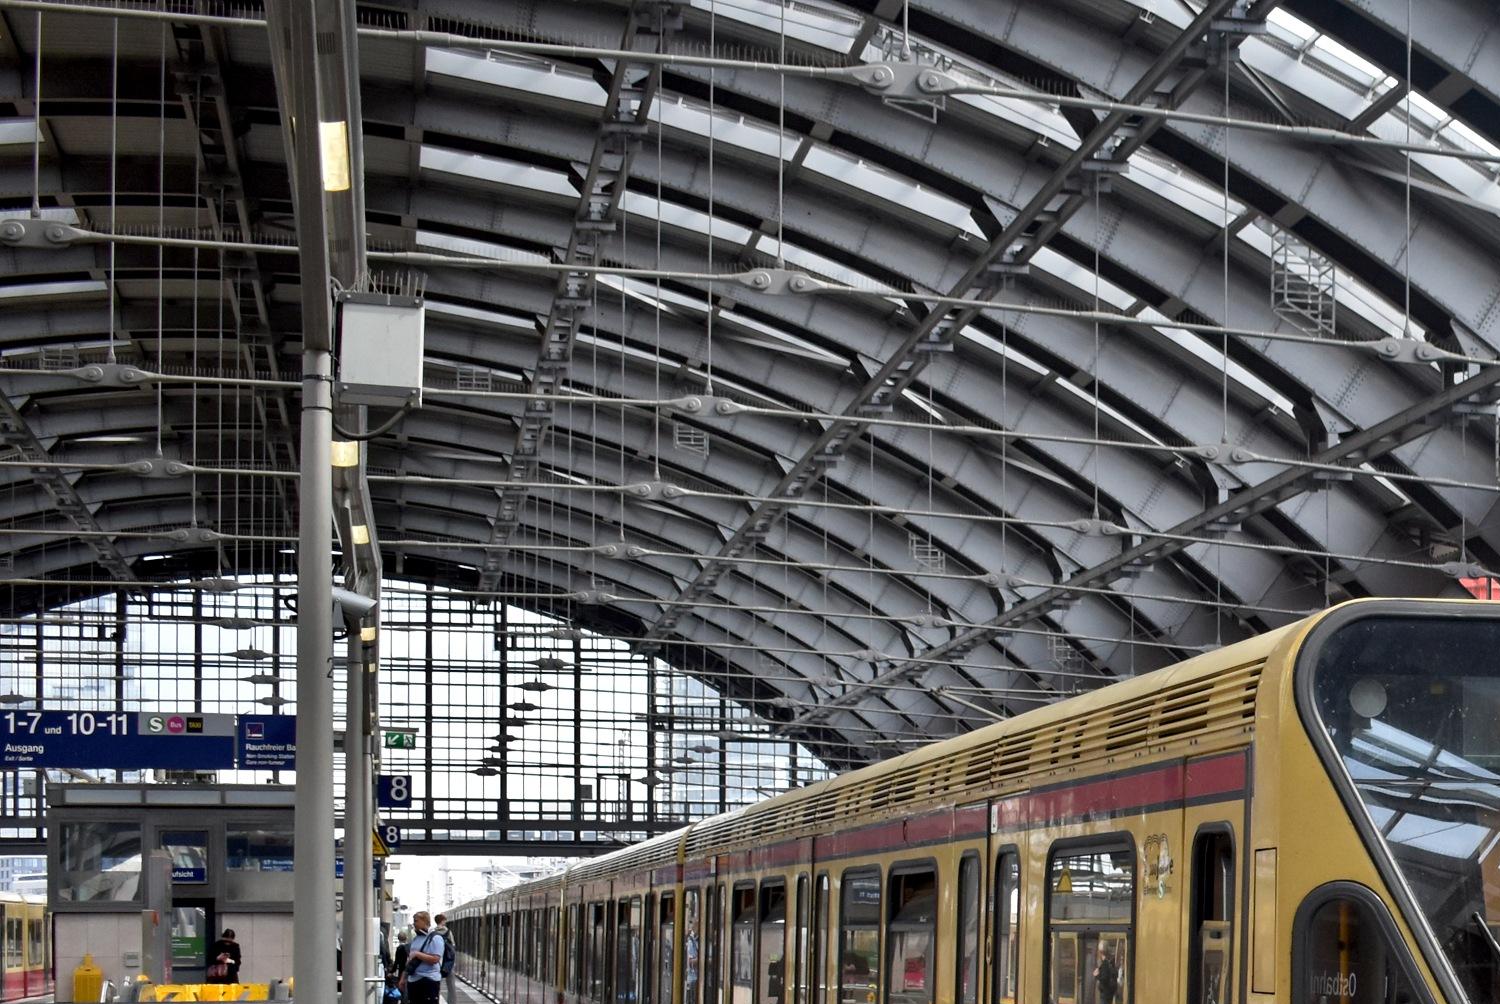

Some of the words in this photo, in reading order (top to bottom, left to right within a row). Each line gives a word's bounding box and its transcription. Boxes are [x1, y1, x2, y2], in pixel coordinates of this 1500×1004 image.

[4, 712, 42, 734] 1-7
[44, 726, 62, 735] und
[67, 712, 128, 736] 10-11
[150, 716, 163, 732] S
[170, 721, 183, 729] Bus
[4, 743, 45, 755] Ausgang
[245, 743, 285, 751] Rauchfreier
[390, 775, 408, 801] 8
[385, 825, 399, 844] 8
